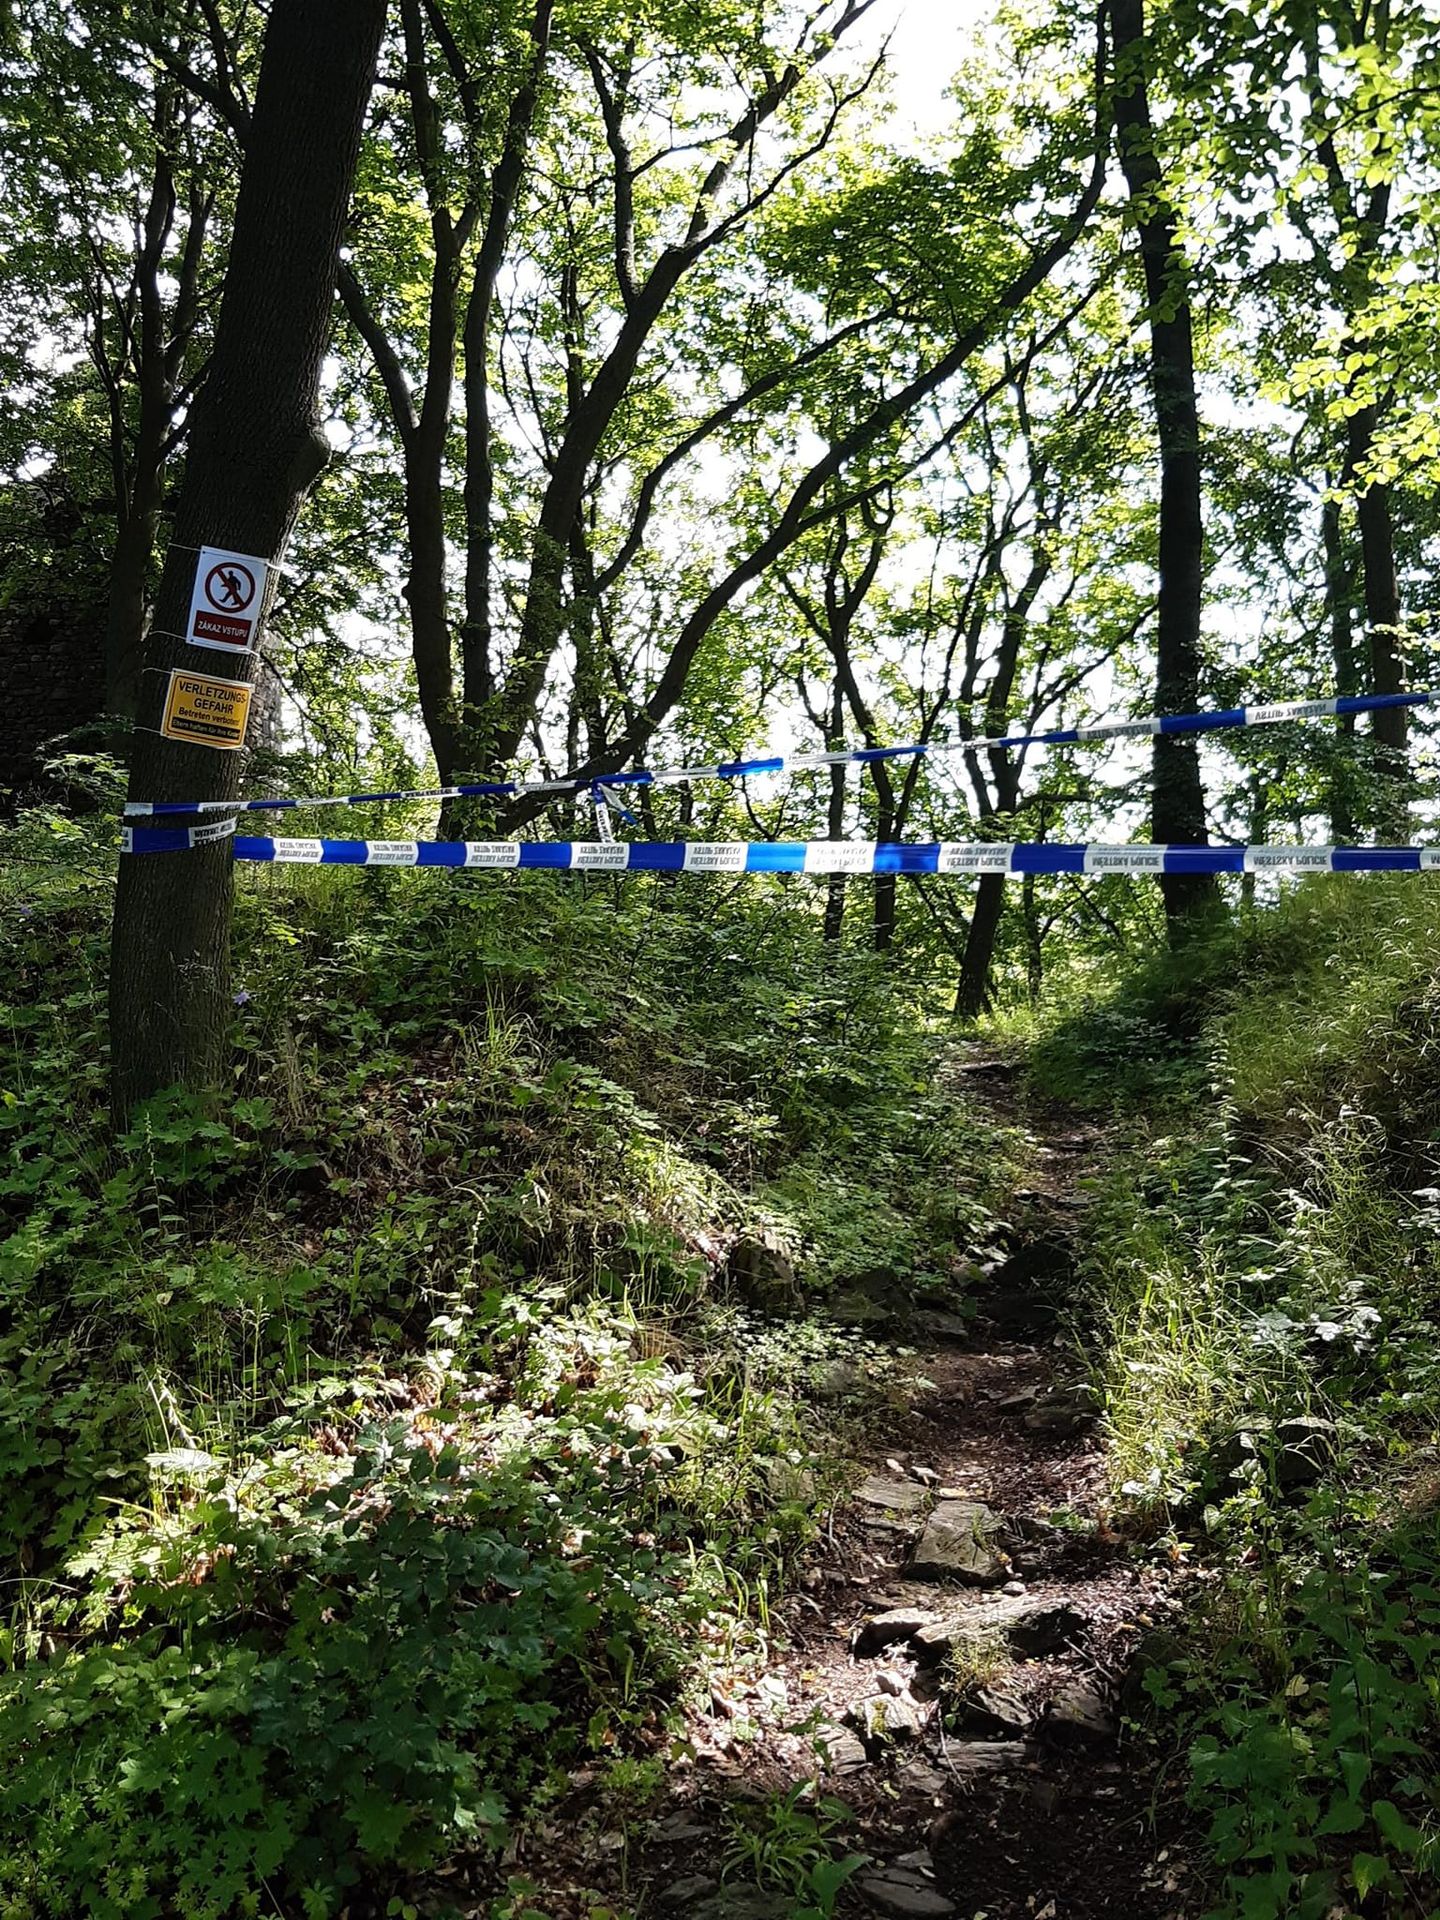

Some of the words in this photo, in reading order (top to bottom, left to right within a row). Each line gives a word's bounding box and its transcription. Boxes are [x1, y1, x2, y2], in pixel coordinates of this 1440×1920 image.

[198, 620, 222, 633] ZÁKAZ
[222, 626, 248, 638] VSTUPU
[179, 707, 210, 720] Betreten
[194, 698, 234, 714] GEFAHR
